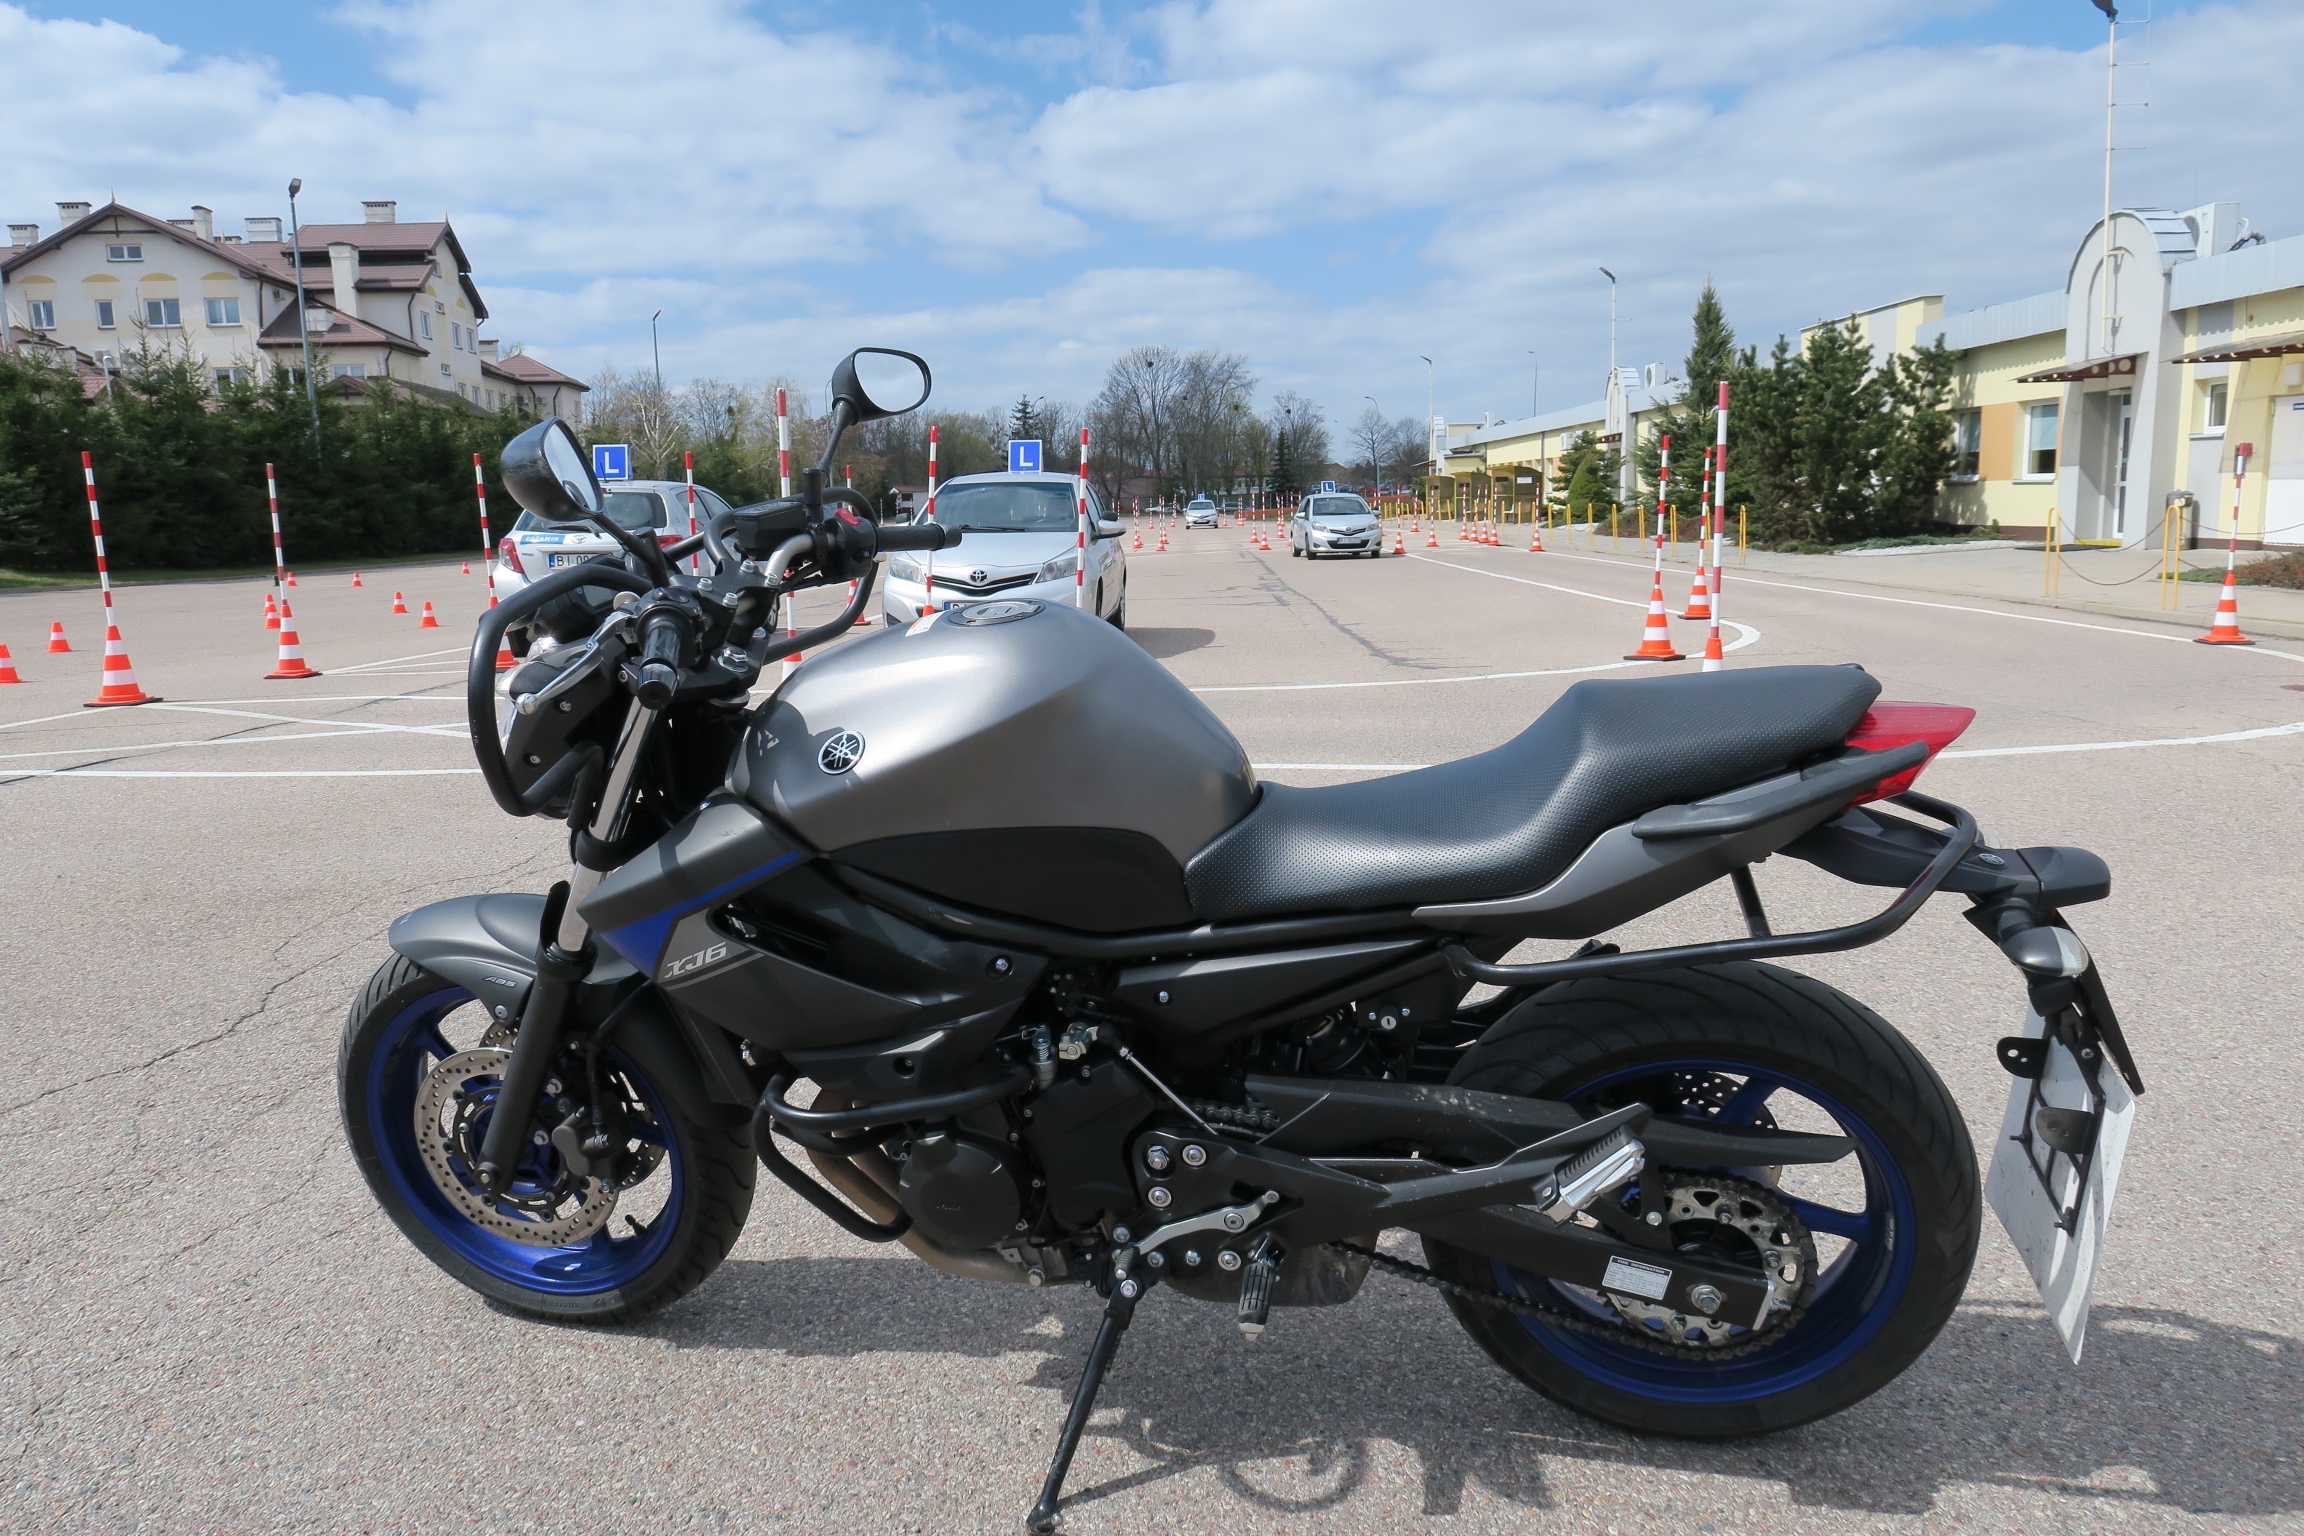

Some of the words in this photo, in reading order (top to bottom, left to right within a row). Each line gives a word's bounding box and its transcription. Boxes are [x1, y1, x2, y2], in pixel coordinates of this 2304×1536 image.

[604, 451, 620, 474] L
[1020, 446, 1033, 467] L
[1325, 483, 1333, 491] L
[556, 555, 571, 567] BI
[664, 941, 727, 979] XJ6
